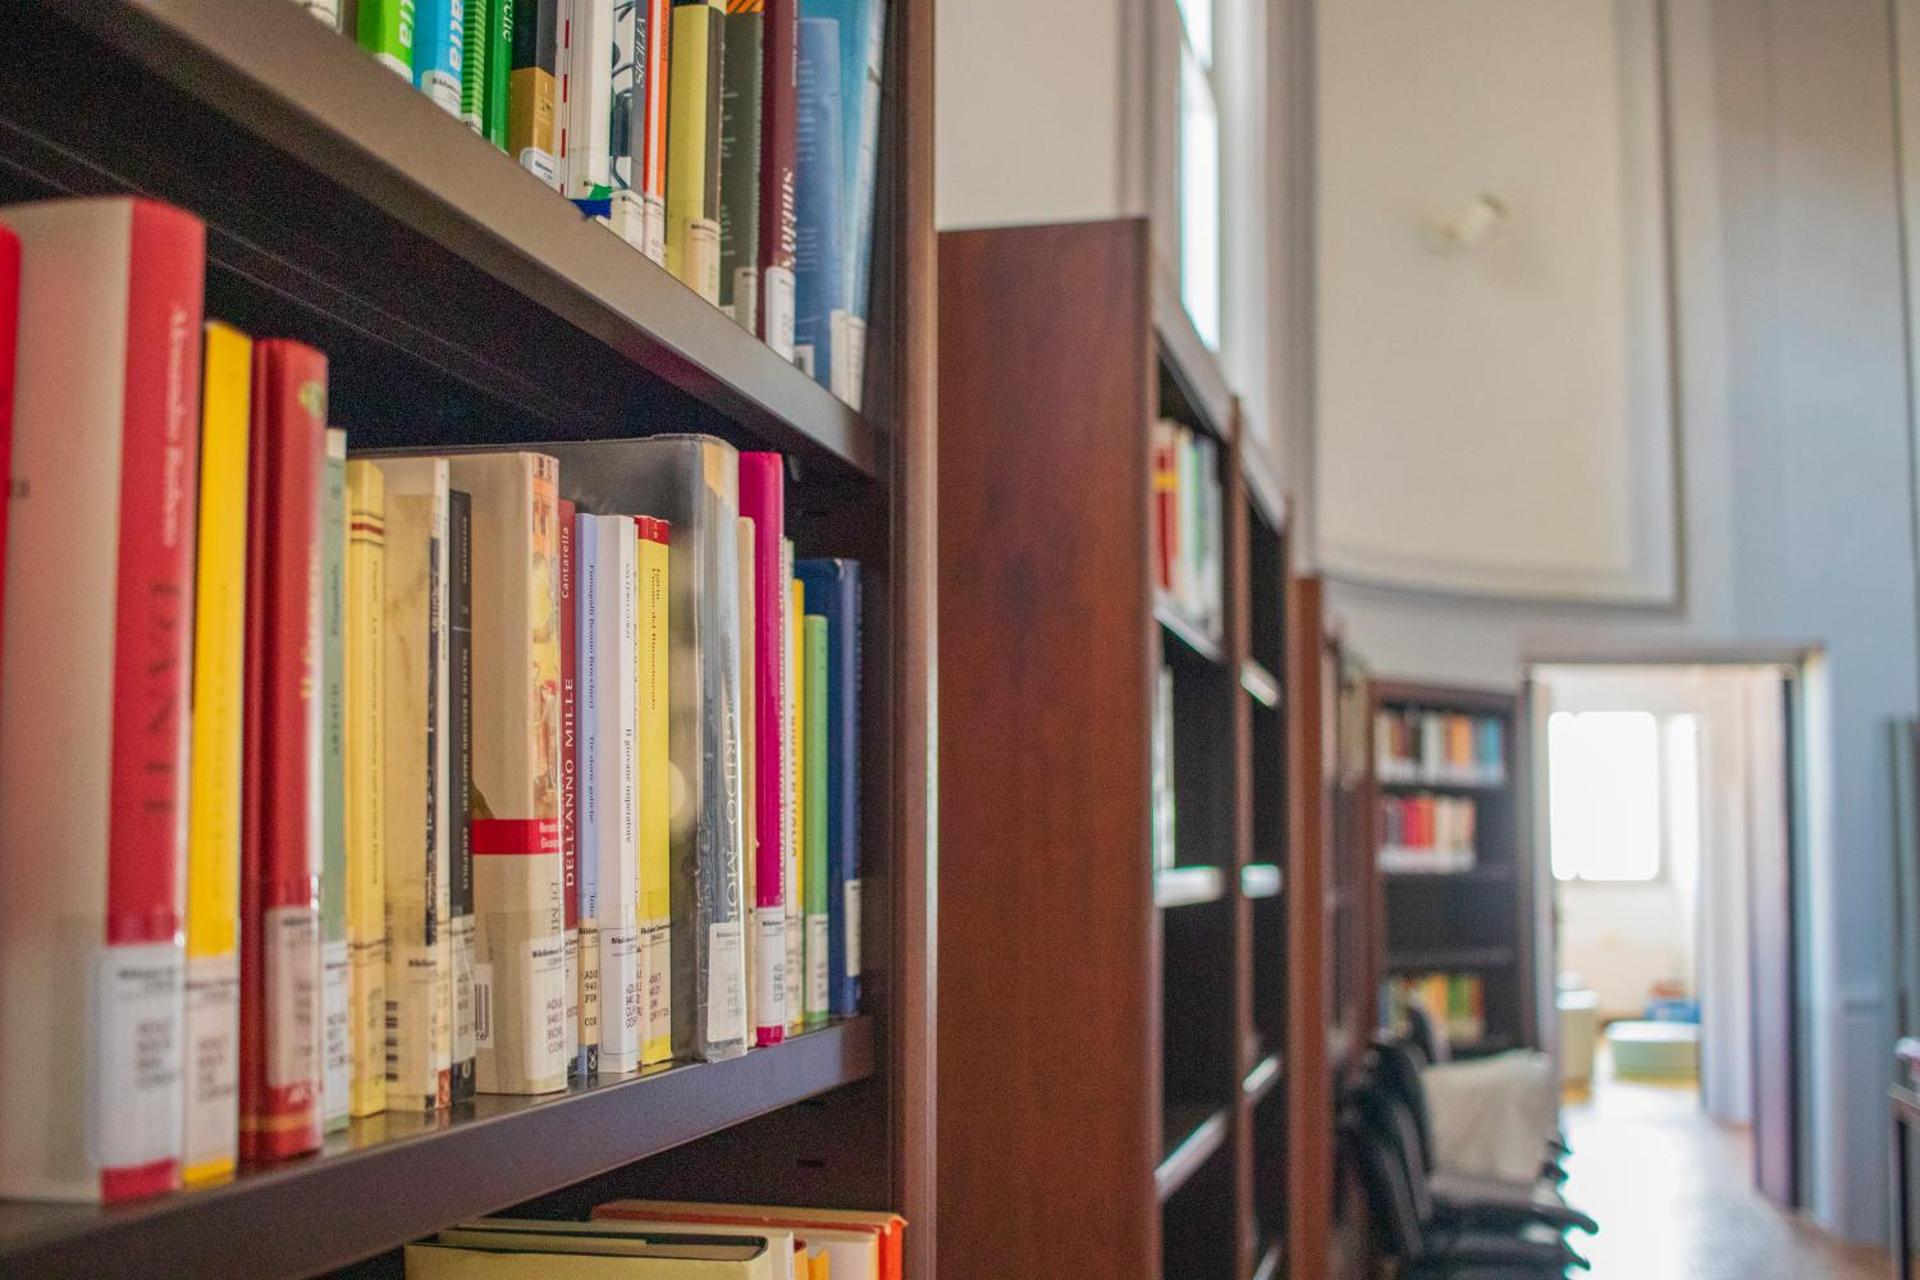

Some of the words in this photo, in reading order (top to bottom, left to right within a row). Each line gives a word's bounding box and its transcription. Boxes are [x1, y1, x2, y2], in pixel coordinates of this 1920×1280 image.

[635, 17, 646, 88] SICILIA
[561, 527, 570, 599] Cantarella
[565, 678, 574, 747] MILLE
[565, 759, 574, 887] DELL'ANNO
